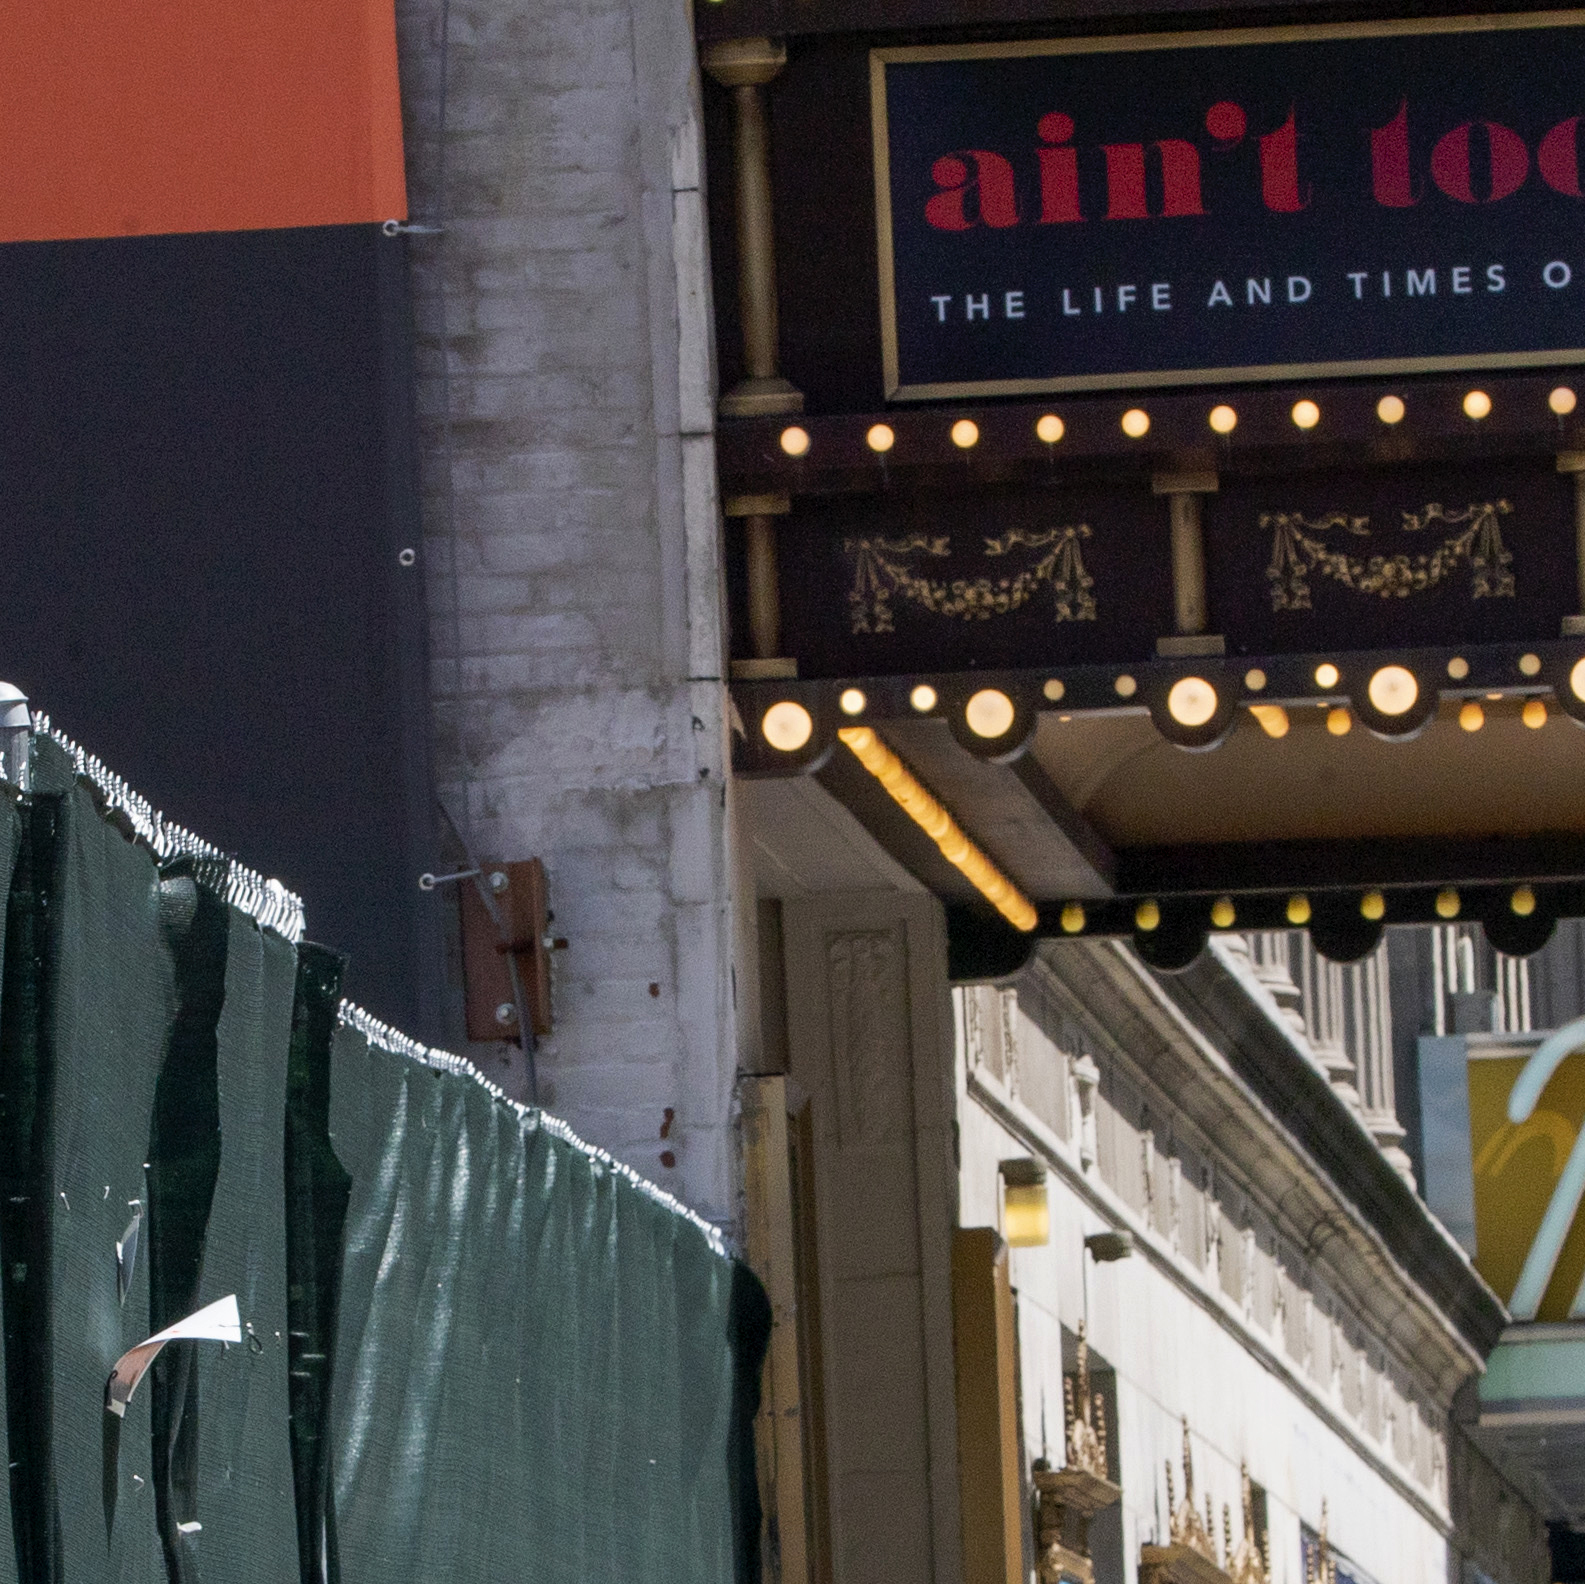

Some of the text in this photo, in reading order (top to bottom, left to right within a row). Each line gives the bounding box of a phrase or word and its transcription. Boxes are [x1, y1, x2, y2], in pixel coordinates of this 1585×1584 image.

[924, 101, 1312, 231] ain't
[932, 291, 1025, 322] THE
[1063, 284, 1173, 315] LIFE
[1208, 276, 1312, 307] AND
[1348, 264, 1507, 298] TIMES
